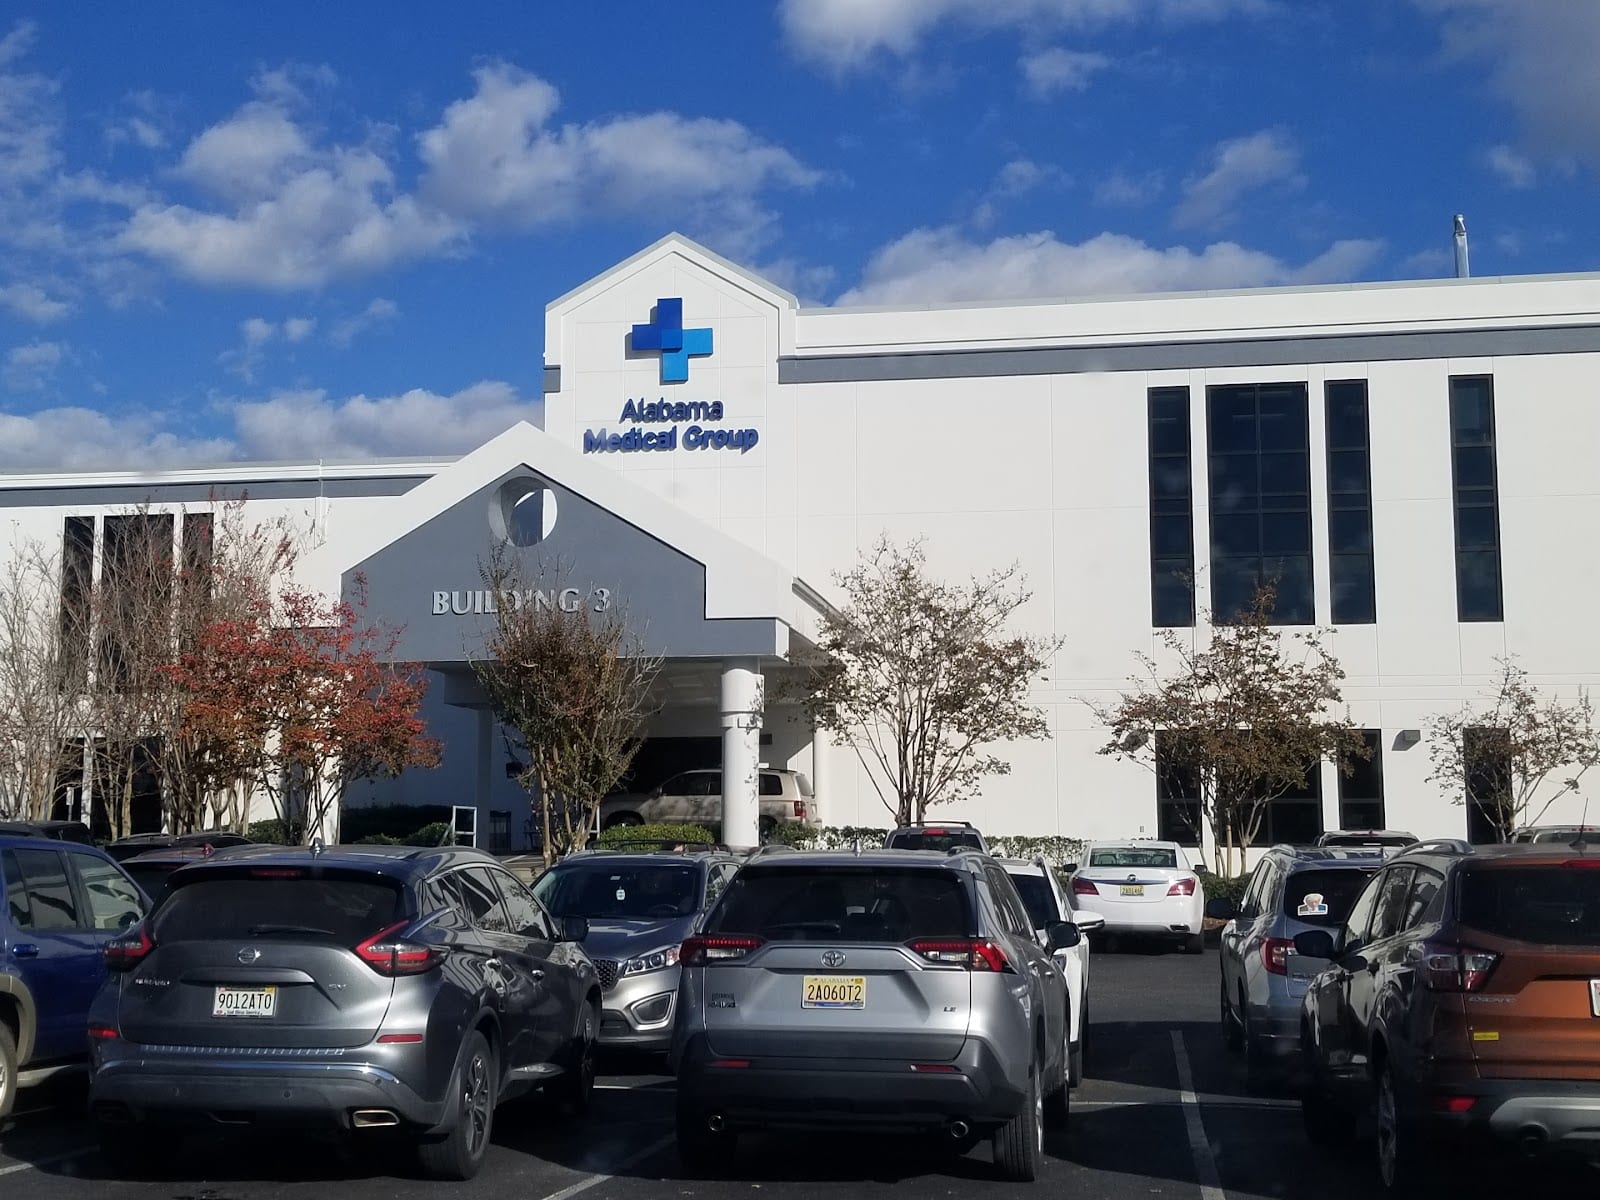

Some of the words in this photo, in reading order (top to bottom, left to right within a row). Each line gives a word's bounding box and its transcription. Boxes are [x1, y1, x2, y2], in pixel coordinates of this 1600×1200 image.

[619, 397, 723, 424] Alabama
[583, 426, 677, 454] Medical
[682, 425, 758, 455] Group
[432, 588, 580, 615] BUILDING
[594, 588, 611, 612] 3
[807, 984, 862, 1001] 2A060T2
